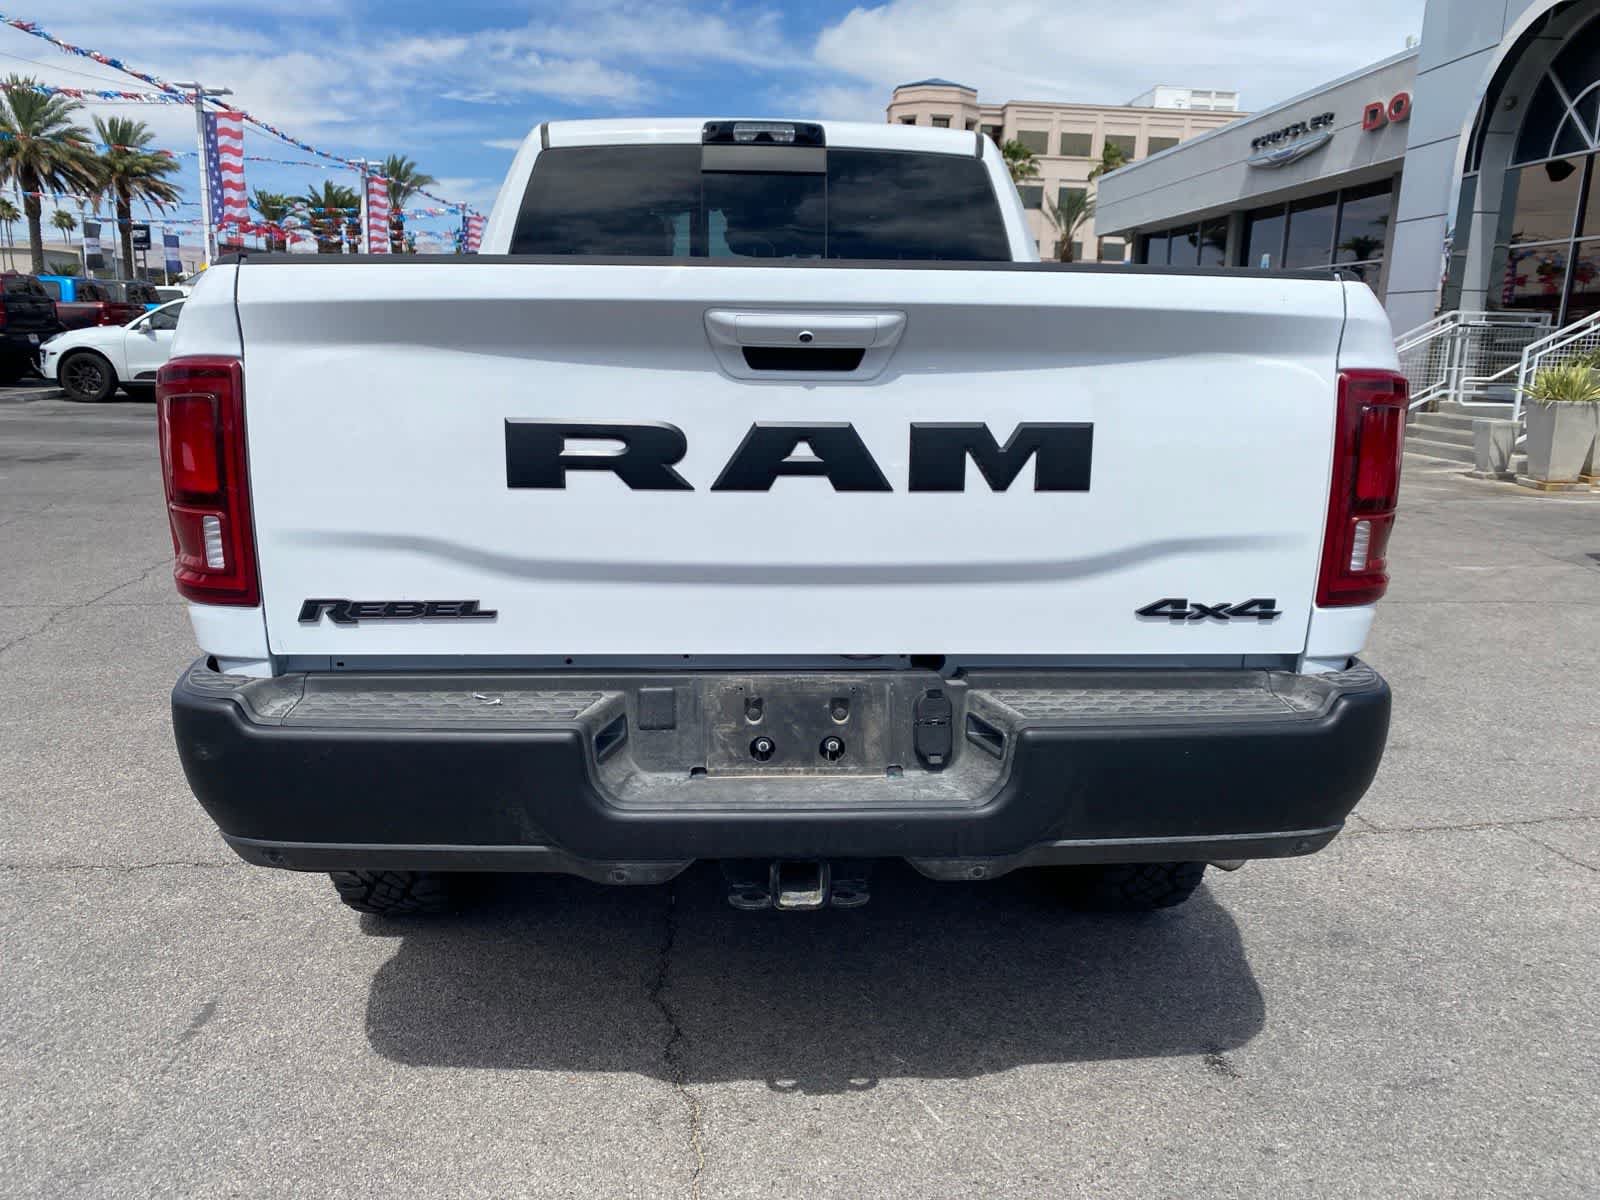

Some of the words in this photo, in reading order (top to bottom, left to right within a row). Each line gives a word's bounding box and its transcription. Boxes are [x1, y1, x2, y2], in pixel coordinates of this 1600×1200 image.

[504, 416, 1094, 492] RAM
[298, 598, 498, 627] REBEL
[1135, 598, 1283, 620] 4x4
